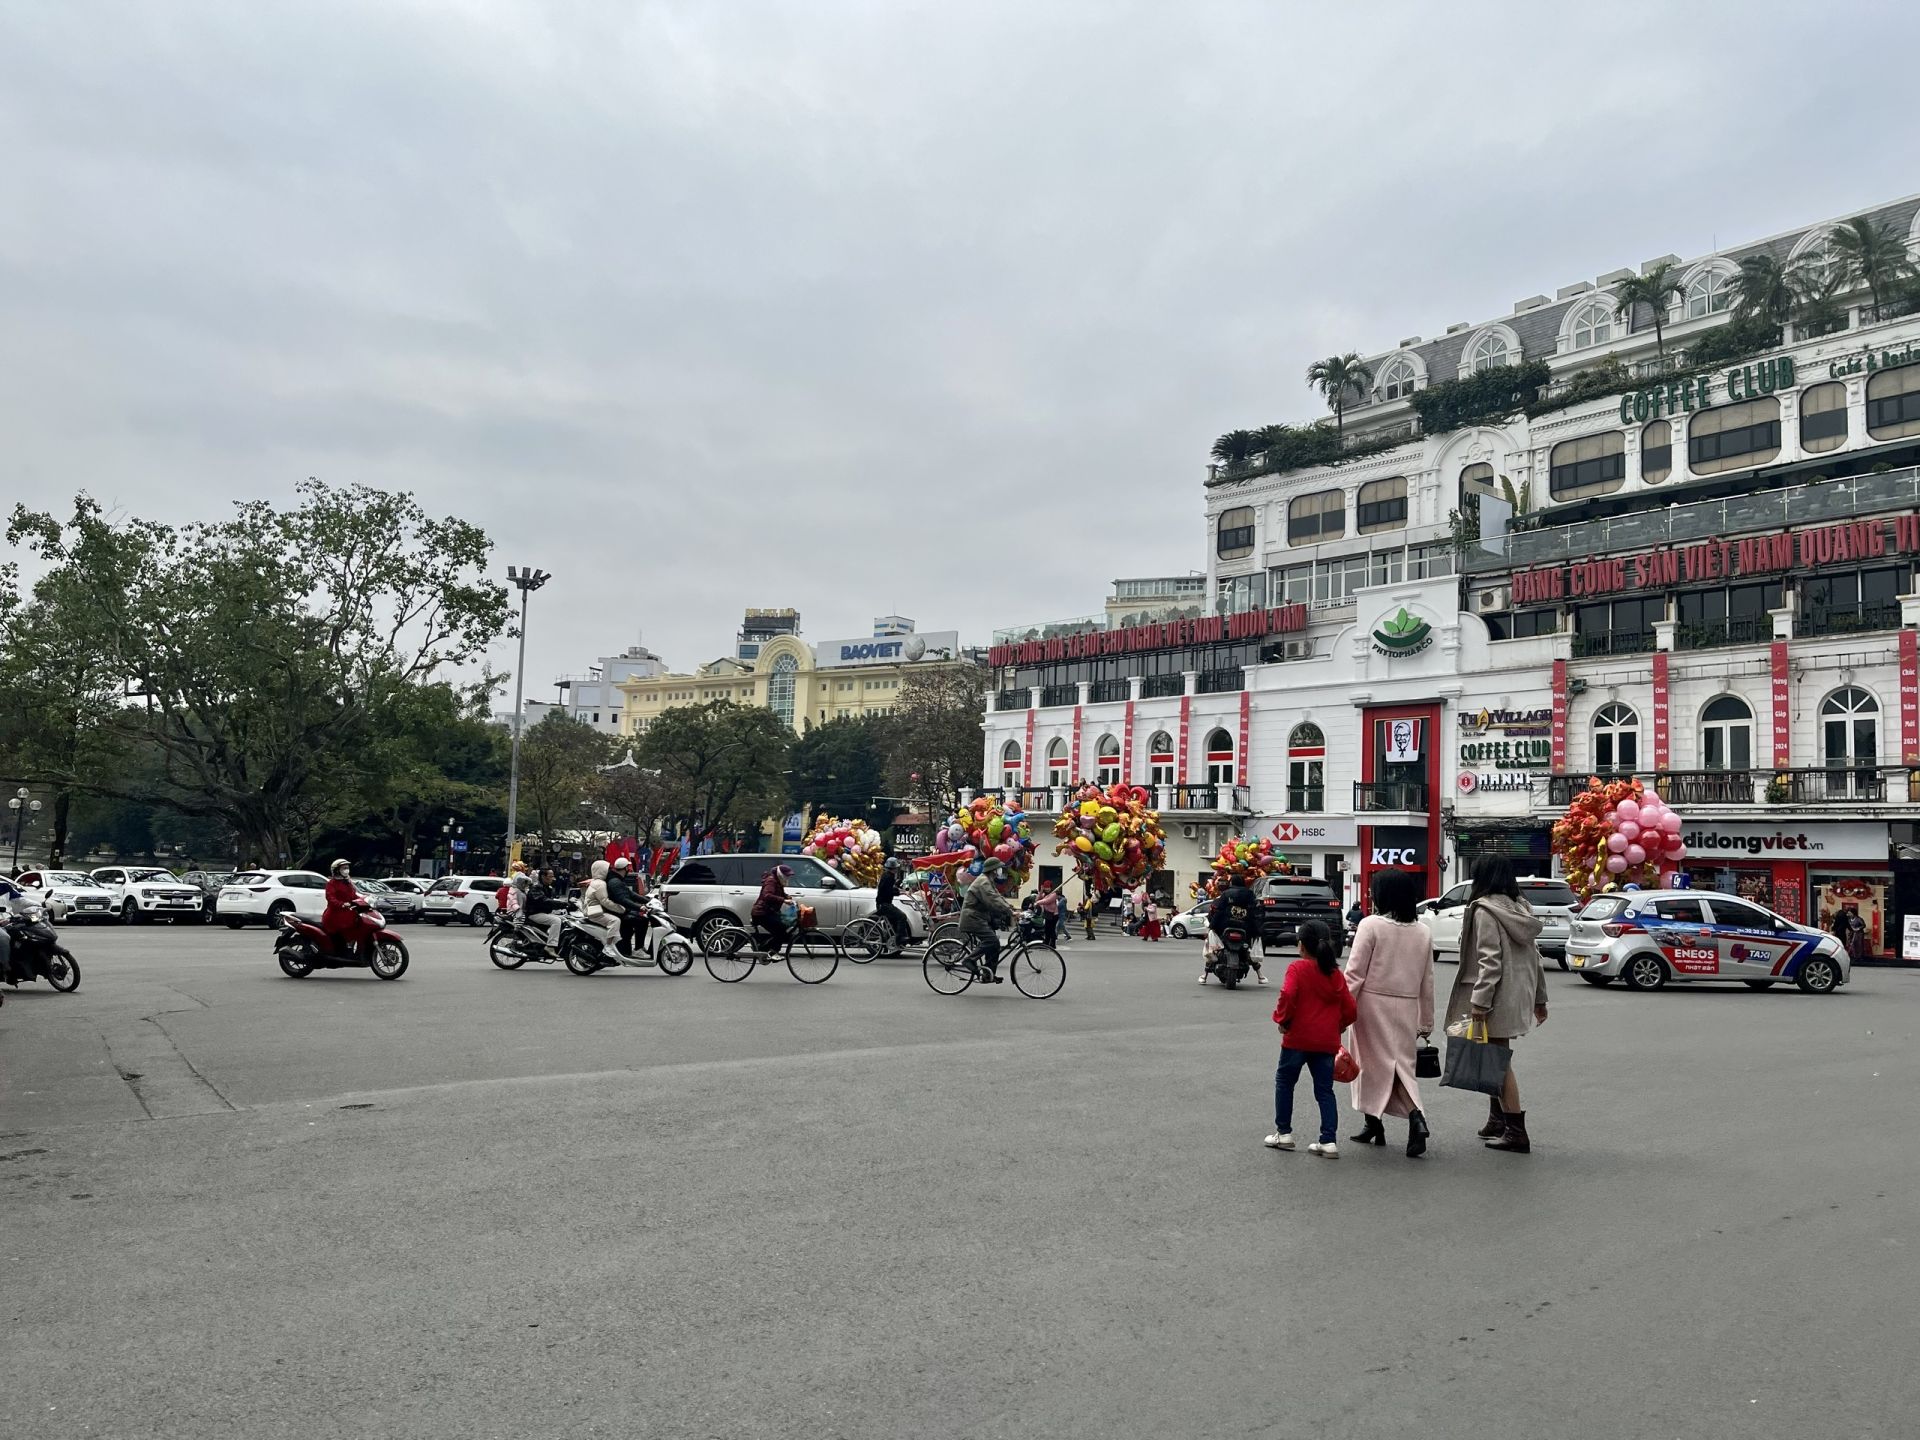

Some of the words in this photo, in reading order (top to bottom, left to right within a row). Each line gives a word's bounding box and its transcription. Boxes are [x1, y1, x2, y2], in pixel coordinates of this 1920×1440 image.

[1620, 376, 1711, 425] COFFEE
[1728, 356, 1795, 401] CLUB
[1738, 533, 1794, 575] NAM
[1800, 519, 1885, 570] QUANG
[1372, 637, 1433, 658] PHYTOPHARCO
[1461, 742, 1510, 760] COFFEE
[1515, 740, 1550, 758] CLUB
[1301, 828, 1325, 837] HSBC
[1683, 831, 1824, 854] didongviet.vn
[1370, 848, 1416, 866] KFC
[1674, 949, 1714, 959] ENEOS
[1750, 950, 1770, 959] TAXI
